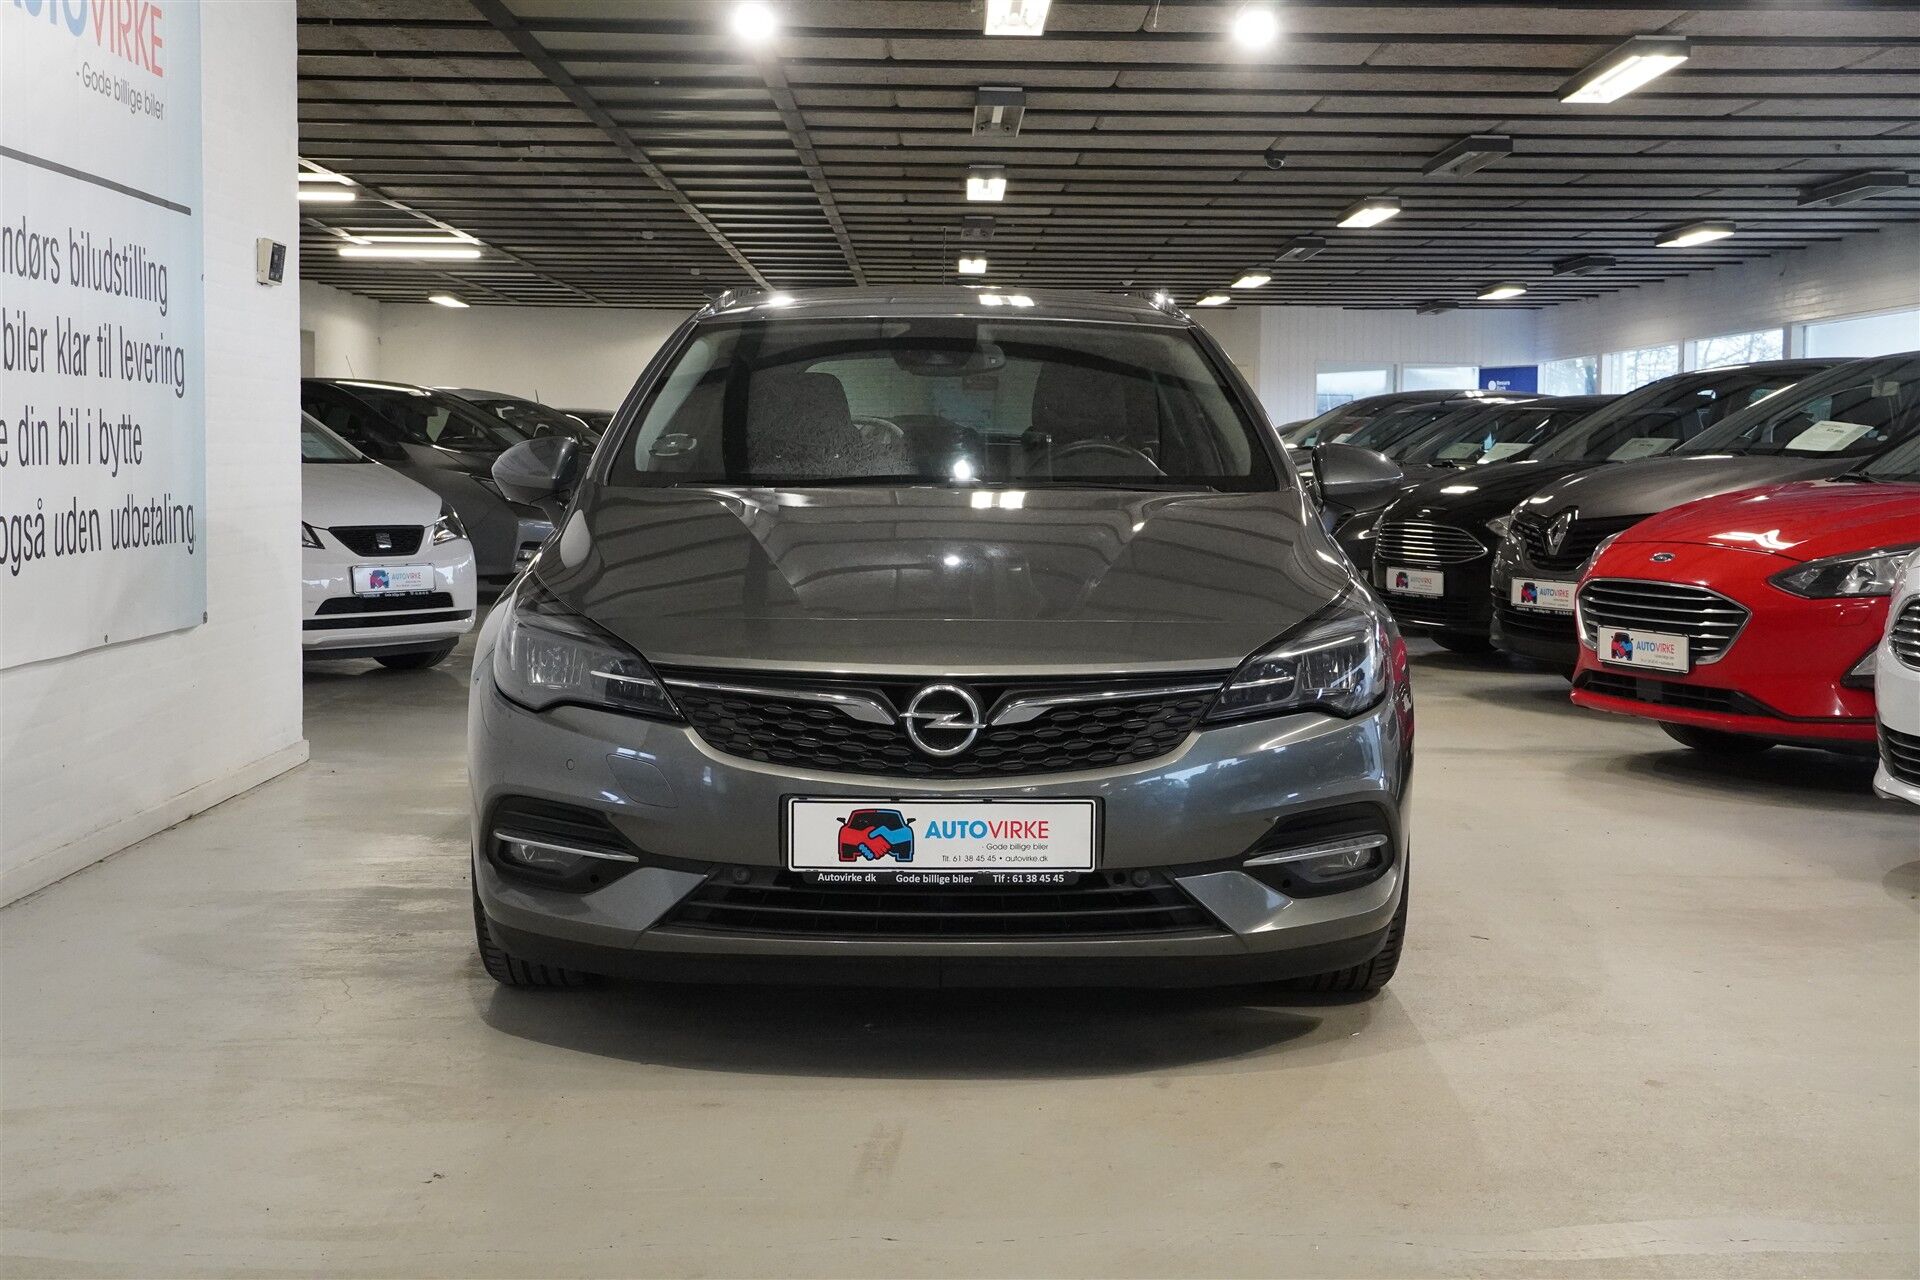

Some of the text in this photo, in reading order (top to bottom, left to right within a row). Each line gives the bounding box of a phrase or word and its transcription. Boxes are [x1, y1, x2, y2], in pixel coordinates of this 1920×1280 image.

[13, 0, 163, 78] OVIRKE
[82, 61, 112, 97] Gode
[114, 76, 142, 114] billige
[144, 90, 164, 120] biler
[2, 216, 168, 317] ndørs biludstilling
[3, 307, 185, 399] biler klar til levering
[18, 405, 49, 466] din
[59, 406, 79, 465] bil
[87, 408, 91, 464] i
[100, 408, 143, 477] bytte
[55, 496, 102, 556] uden
[1636, 640, 1675, 654] AUTOVIRKE
[924, 820, 1049, 839] AUTOVIRKE
[1009, 843, 1031, 852] billige
[817, 873, 863, 883] Autovirke
[865, 873, 877, 883] dk
[895, 874, 921, 883] Gode
[922, 874, 950, 885] billige
[952, 874, 974, 883] biler
[1012, 874, 1024, 883] 61
[1025, 874, 1038, 883] 38
[1039, 874, 1051, 883] 45
[1052, 874, 1065, 883] 45
